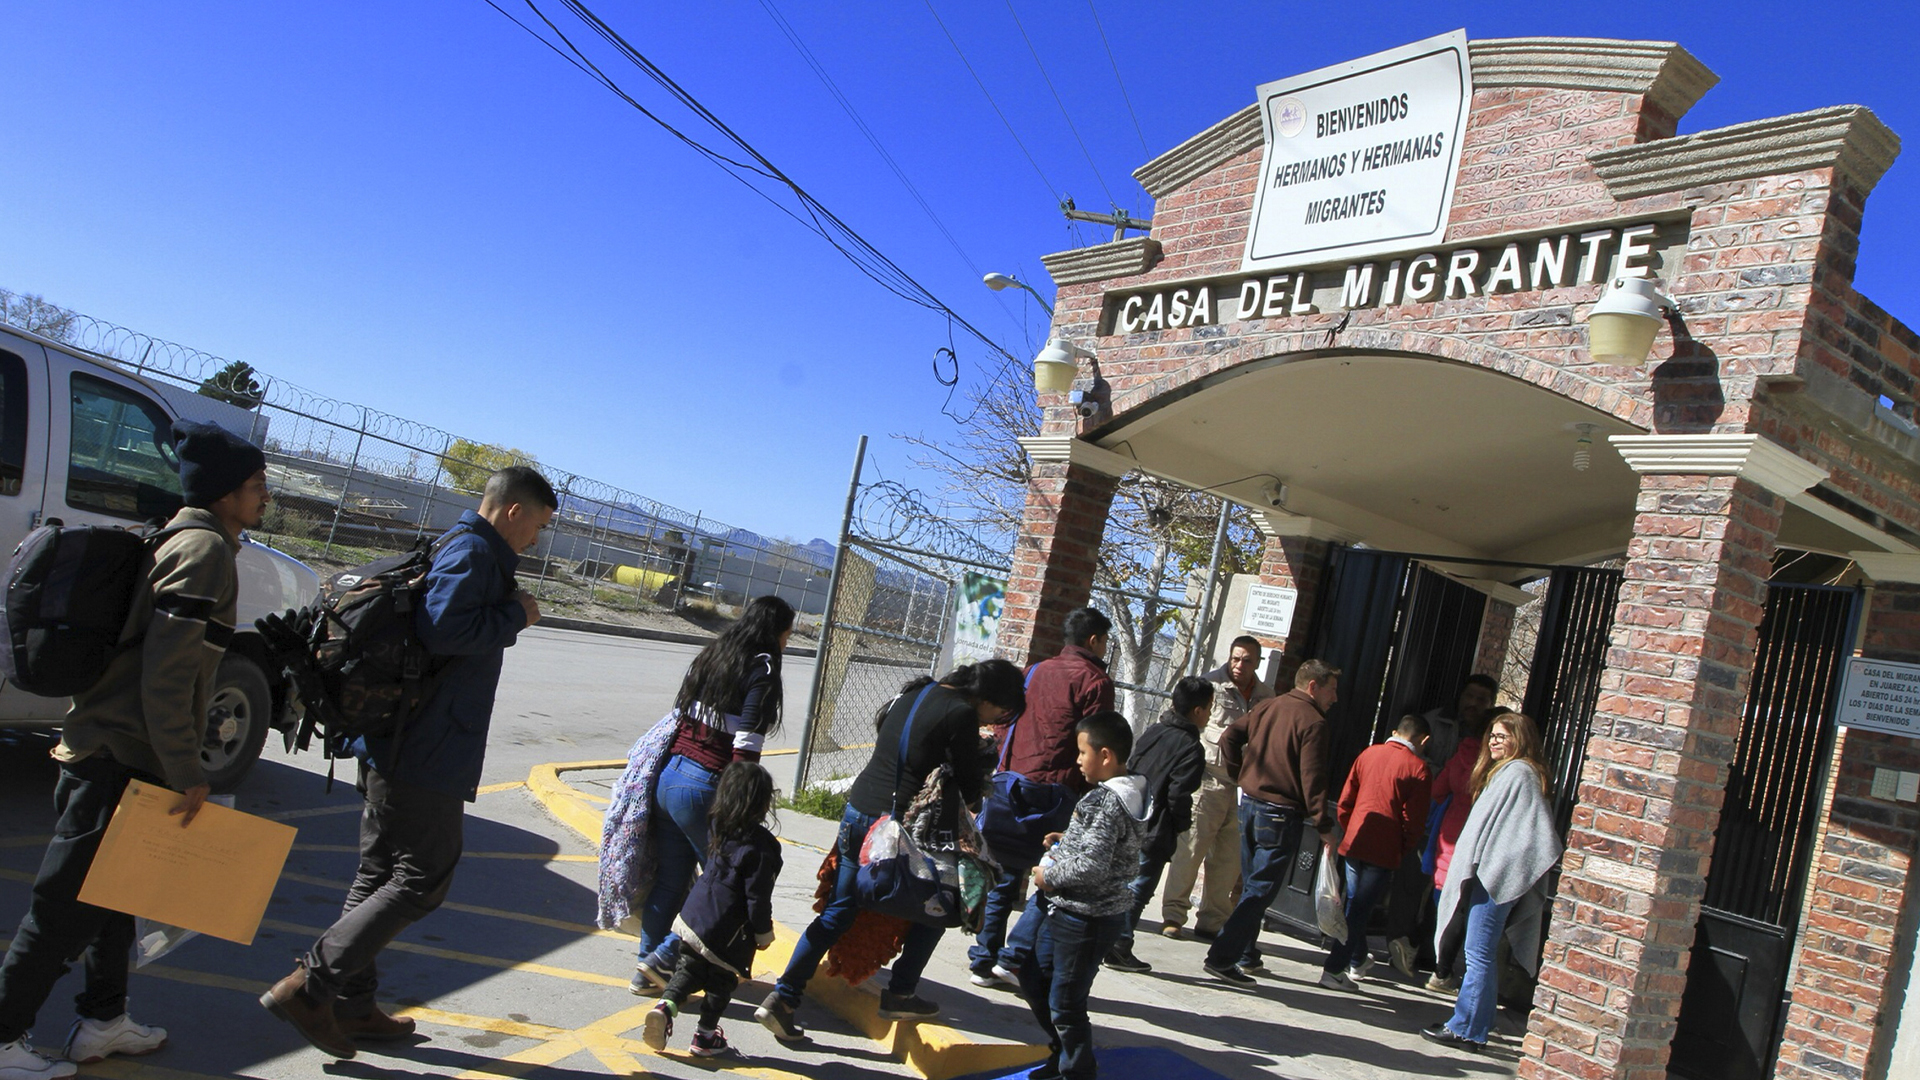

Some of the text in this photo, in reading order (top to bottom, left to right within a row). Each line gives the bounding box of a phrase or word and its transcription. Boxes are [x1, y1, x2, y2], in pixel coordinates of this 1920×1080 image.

[1316, 92, 1408, 139] BIENVENIDOS
[1273, 131, 1444, 189] HERMANOS Y HERMANAS
[1304, 188, 1386, 225] MIGRANTES
[1121, 223, 1656, 332] CASA DEL MIGRANTE
[1864, 668, 1880, 677] CASA
[1882, 670, 1894, 679] DEL
[1869, 680, 1879, 688] EN
[1880, 682, 1906, 691] JUAREZ
[1861, 690, 1889, 701] ABIERTO
[1890, 694, 1903, 703] LAS
[1904, 696, 1913, 704] 24
[1849, 699, 1862, 708] LOS
[1868, 702, 1883, 711] DIAS
[1885, 704, 1894, 712] DE
[1895, 706, 1903, 714] LA
[1866, 713, 1910, 726] BIENVENIDOS
